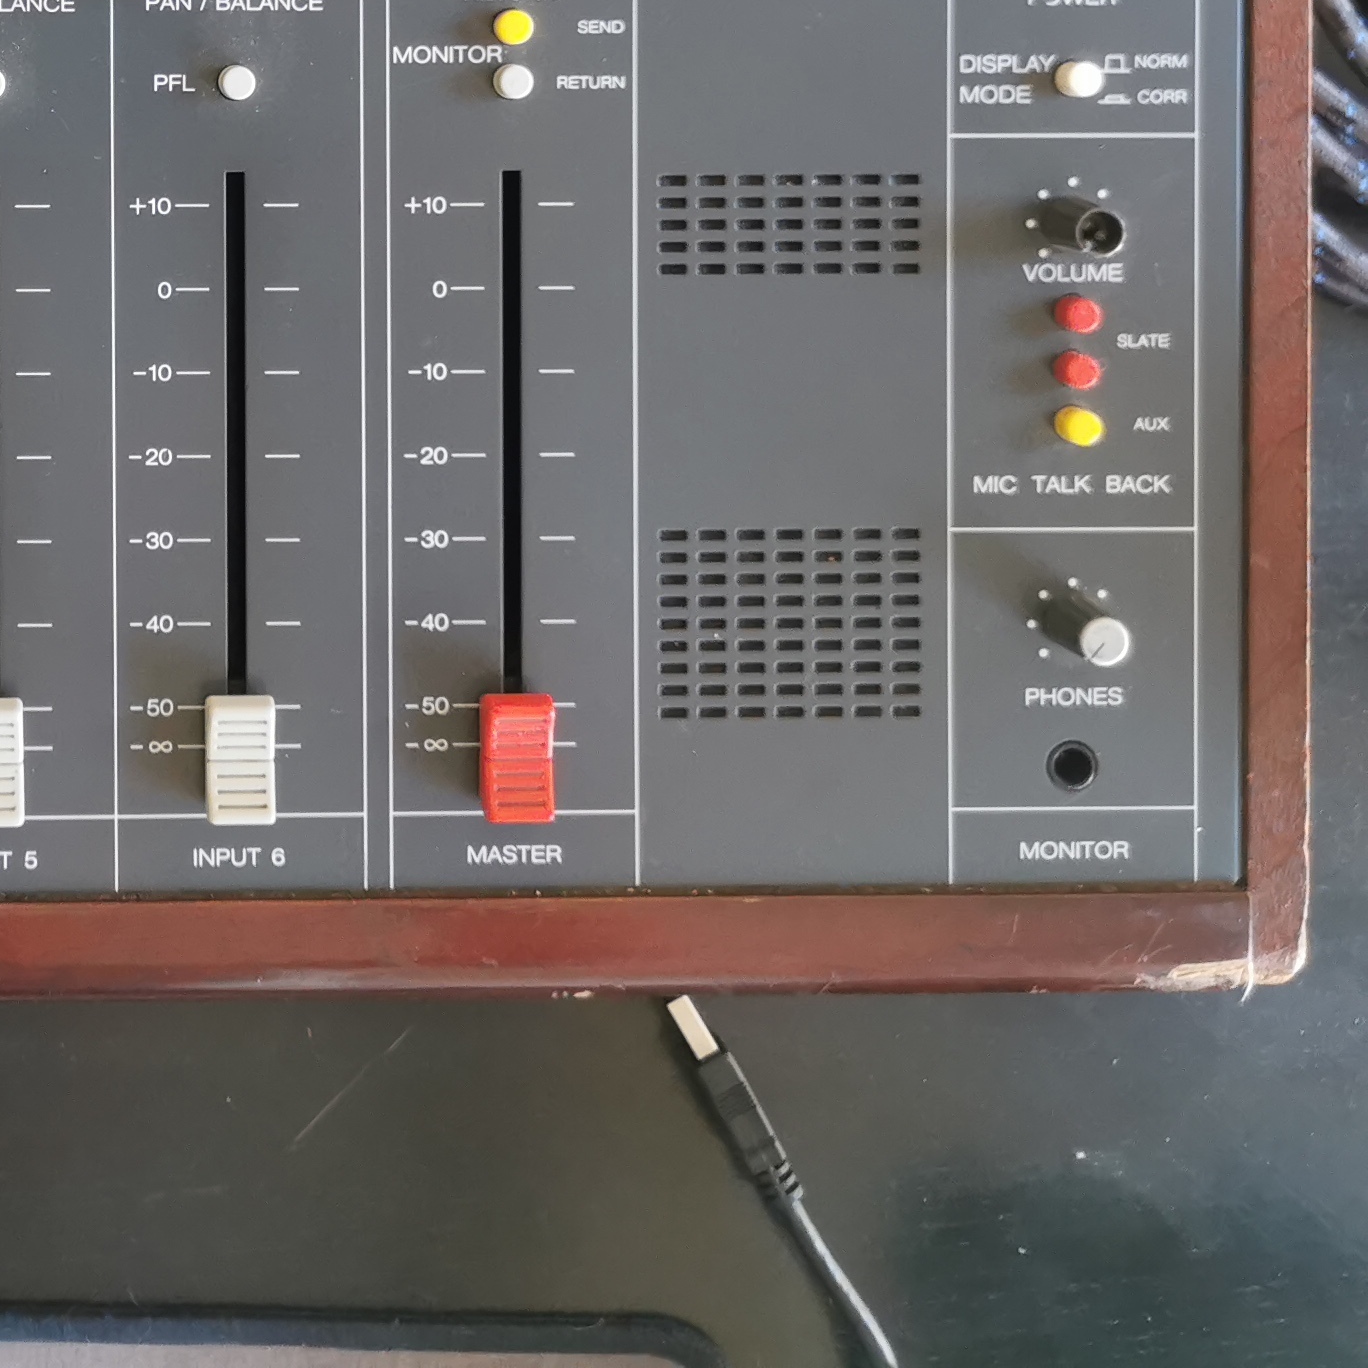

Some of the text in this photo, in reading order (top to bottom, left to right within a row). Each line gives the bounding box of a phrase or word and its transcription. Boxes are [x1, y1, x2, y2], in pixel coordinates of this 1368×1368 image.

[578, 20, 625, 34] SEND
[393, 45, 502, 64] MONITOR
[960, 54, 1056, 73] DISPLAY
[1135, 53, 1188, 69] NORM
[154, 74, 195, 91] PFL
[557, 75, 626, 89] RETURN
[960, 85, 1032, 104] MODE
[1137, 89, 1188, 104] CORR
[405, 197, 447, 214] +10
[1023, 263, 1124, 282] VOLUME
[433, 281, 447, 298] 0
[1117, 333, 1170, 348] SLATE
[408, 363, 447, 380] -10
[1134, 417, 1169, 432] AUX
[404, 447, 448, 465] -20
[973, 475, 1170, 494] MIC TALK BACK
[404, 530, 449, 548] -30
[405, 613, 449, 631] -40
[1025, 687, 1124, 706] PHONES
[405, 697, 449, 715] -50
[193, 847, 285, 867] INPUT 6
[467, 845, 562, 864] MASTER
[1020, 841, 1129, 860] MONITOR
[25, 851, 37, 869] 5
